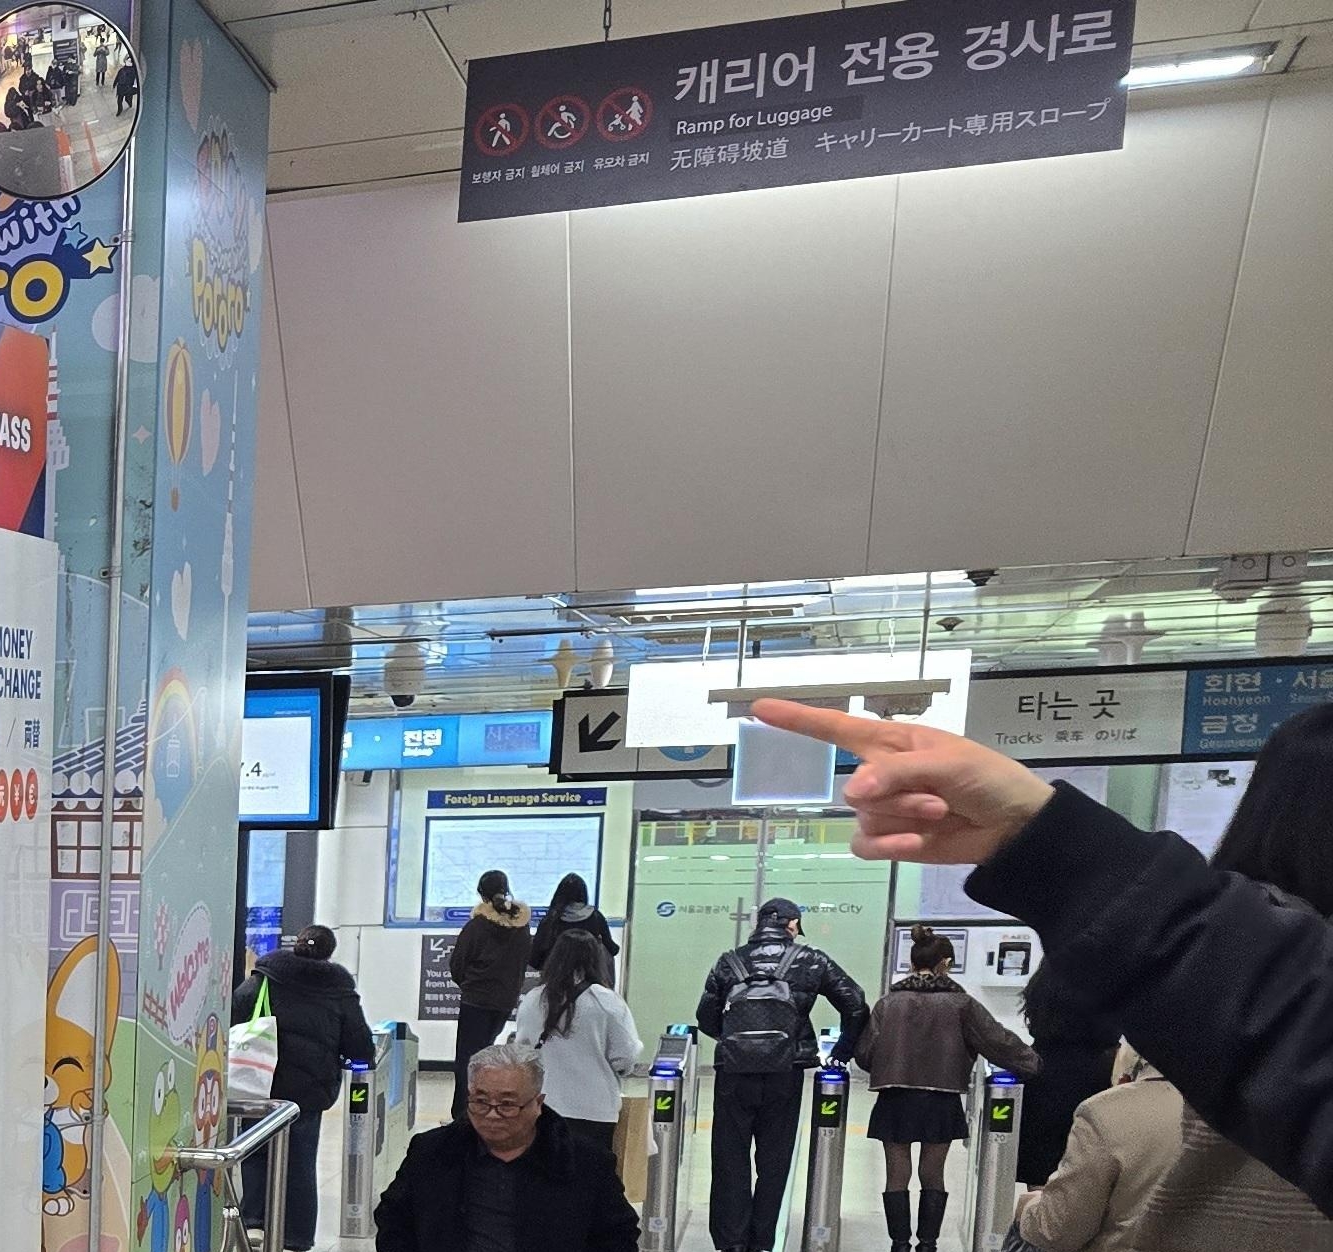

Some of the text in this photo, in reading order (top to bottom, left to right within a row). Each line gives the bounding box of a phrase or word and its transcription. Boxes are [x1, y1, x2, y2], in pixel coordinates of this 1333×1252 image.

[673, 9, 1117, 104] 캐리어 전용 경사로
[676, 103, 833, 136] Ramp for Luggage
[815, 98, 1111, 153] キャリーカート専用スロープ
[593, 152, 650, 170] 유모차 금지
[670, 137, 789, 171] 无障碍坡道
[505, 166, 526, 181] 금지
[563, 159, 584, 174] 금지
[1204, 671, 1262, 693] 회현
[1018, 690, 1121, 722] 타는 곳
[1201, 713, 1260, 734] 금정
[995, 731, 1043, 745] Tracks
[1095, 728, 1136, 742] のりば
[241, 762, 263, 777] .4
[445, 792, 582, 807] Foreign Language Service
[839, 902, 863, 914] City
[426, 969, 442, 978] You
